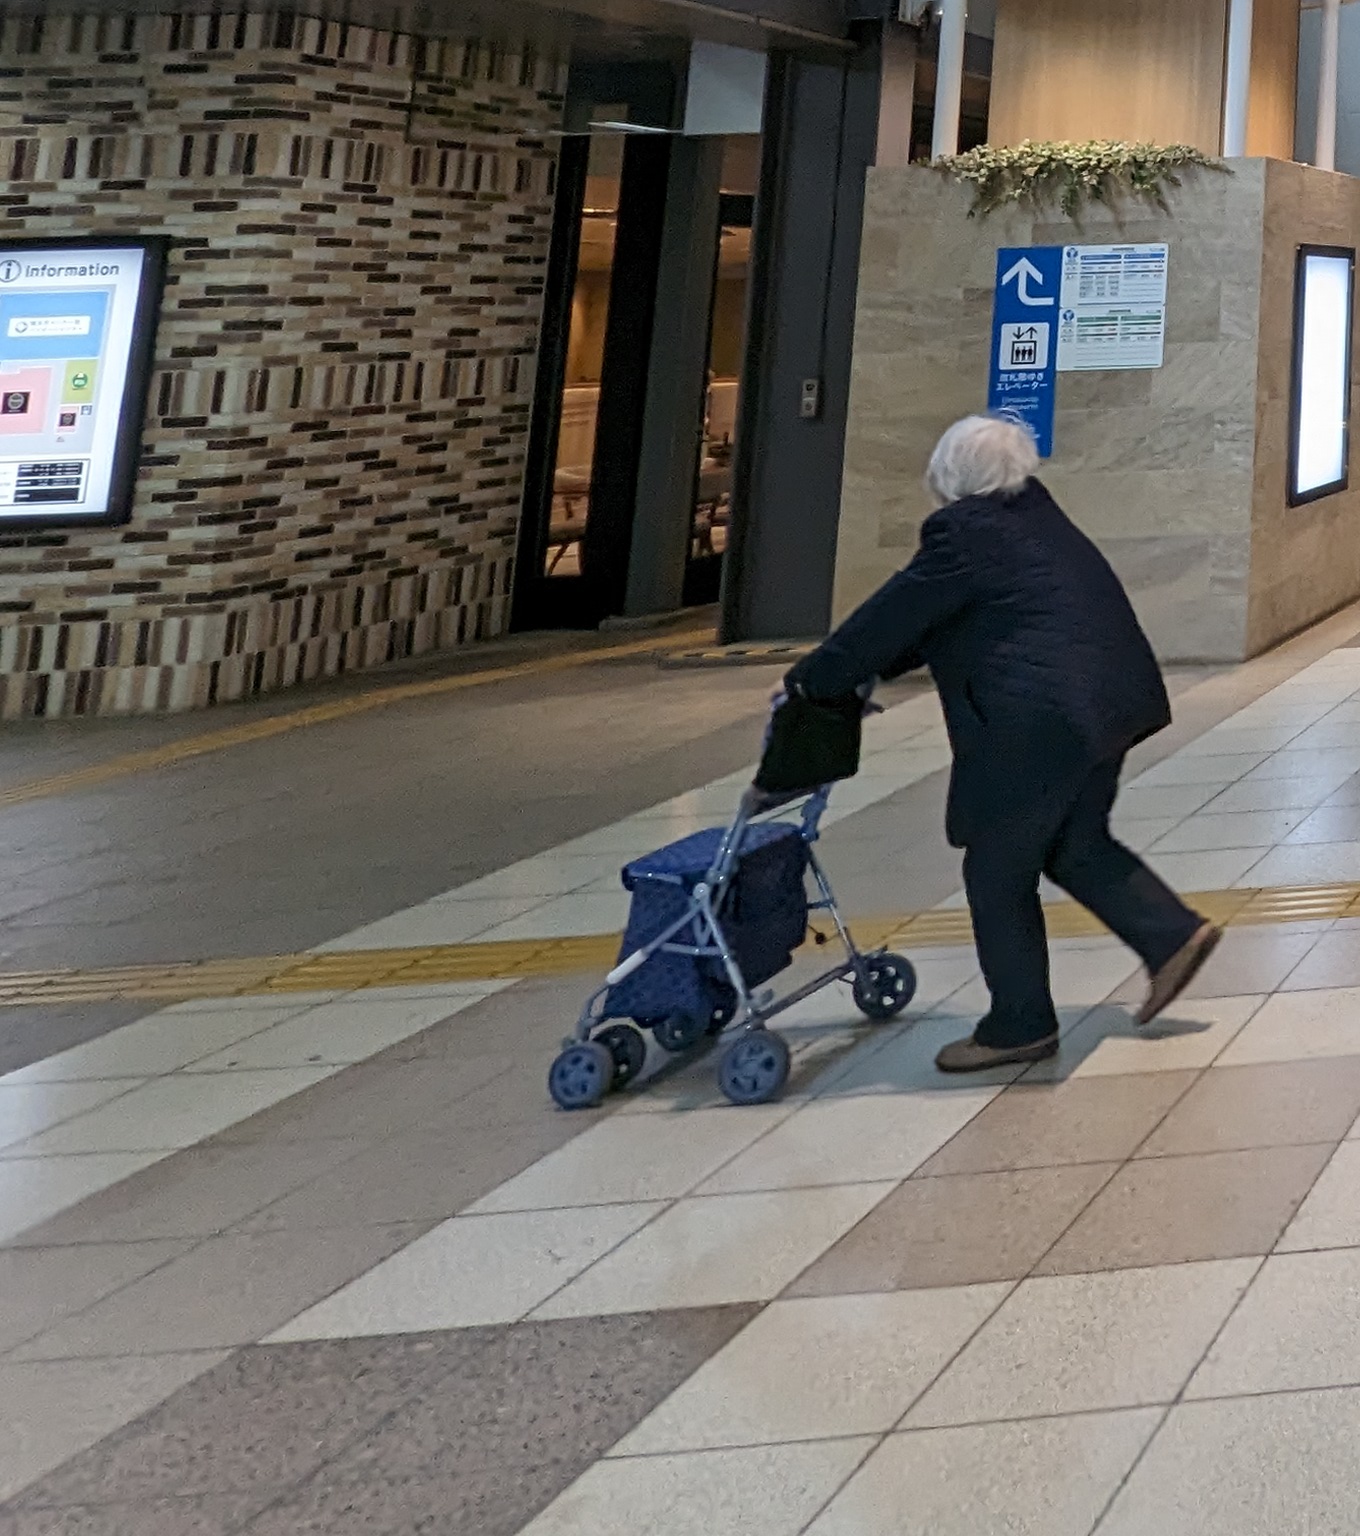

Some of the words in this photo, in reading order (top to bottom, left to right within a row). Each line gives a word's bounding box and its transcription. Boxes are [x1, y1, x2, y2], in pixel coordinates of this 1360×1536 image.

[996, 381, 1048, 391] エレベーター
